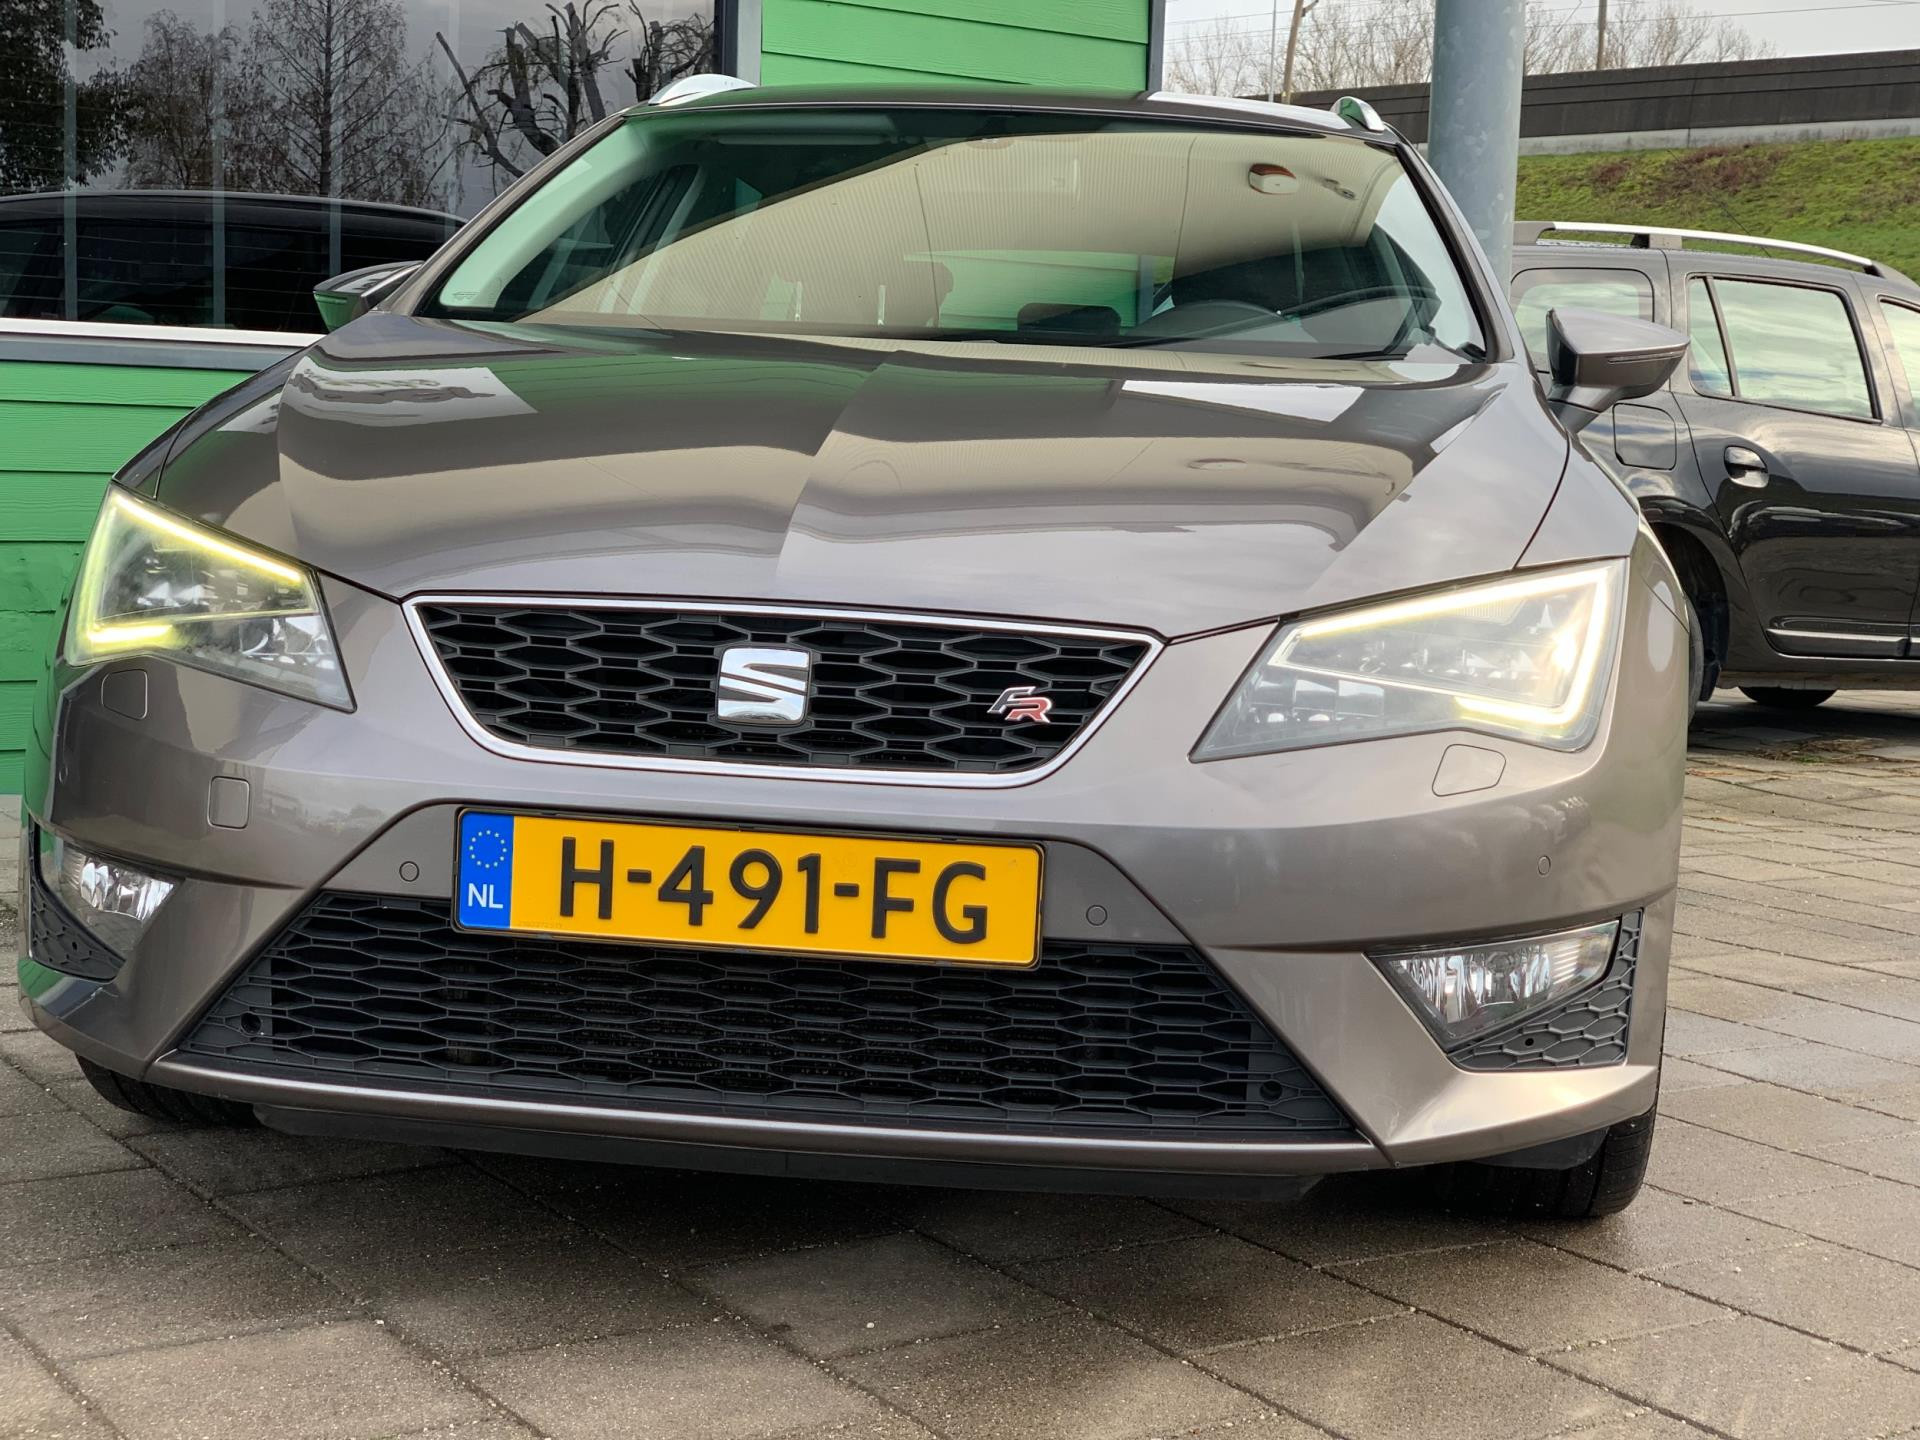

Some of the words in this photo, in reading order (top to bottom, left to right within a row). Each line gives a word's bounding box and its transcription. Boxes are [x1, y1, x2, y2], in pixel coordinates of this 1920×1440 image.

[987, 686, 1051, 723] FR
[468, 883, 504, 909] NL
[559, 836, 988, 944] H-491-FG
